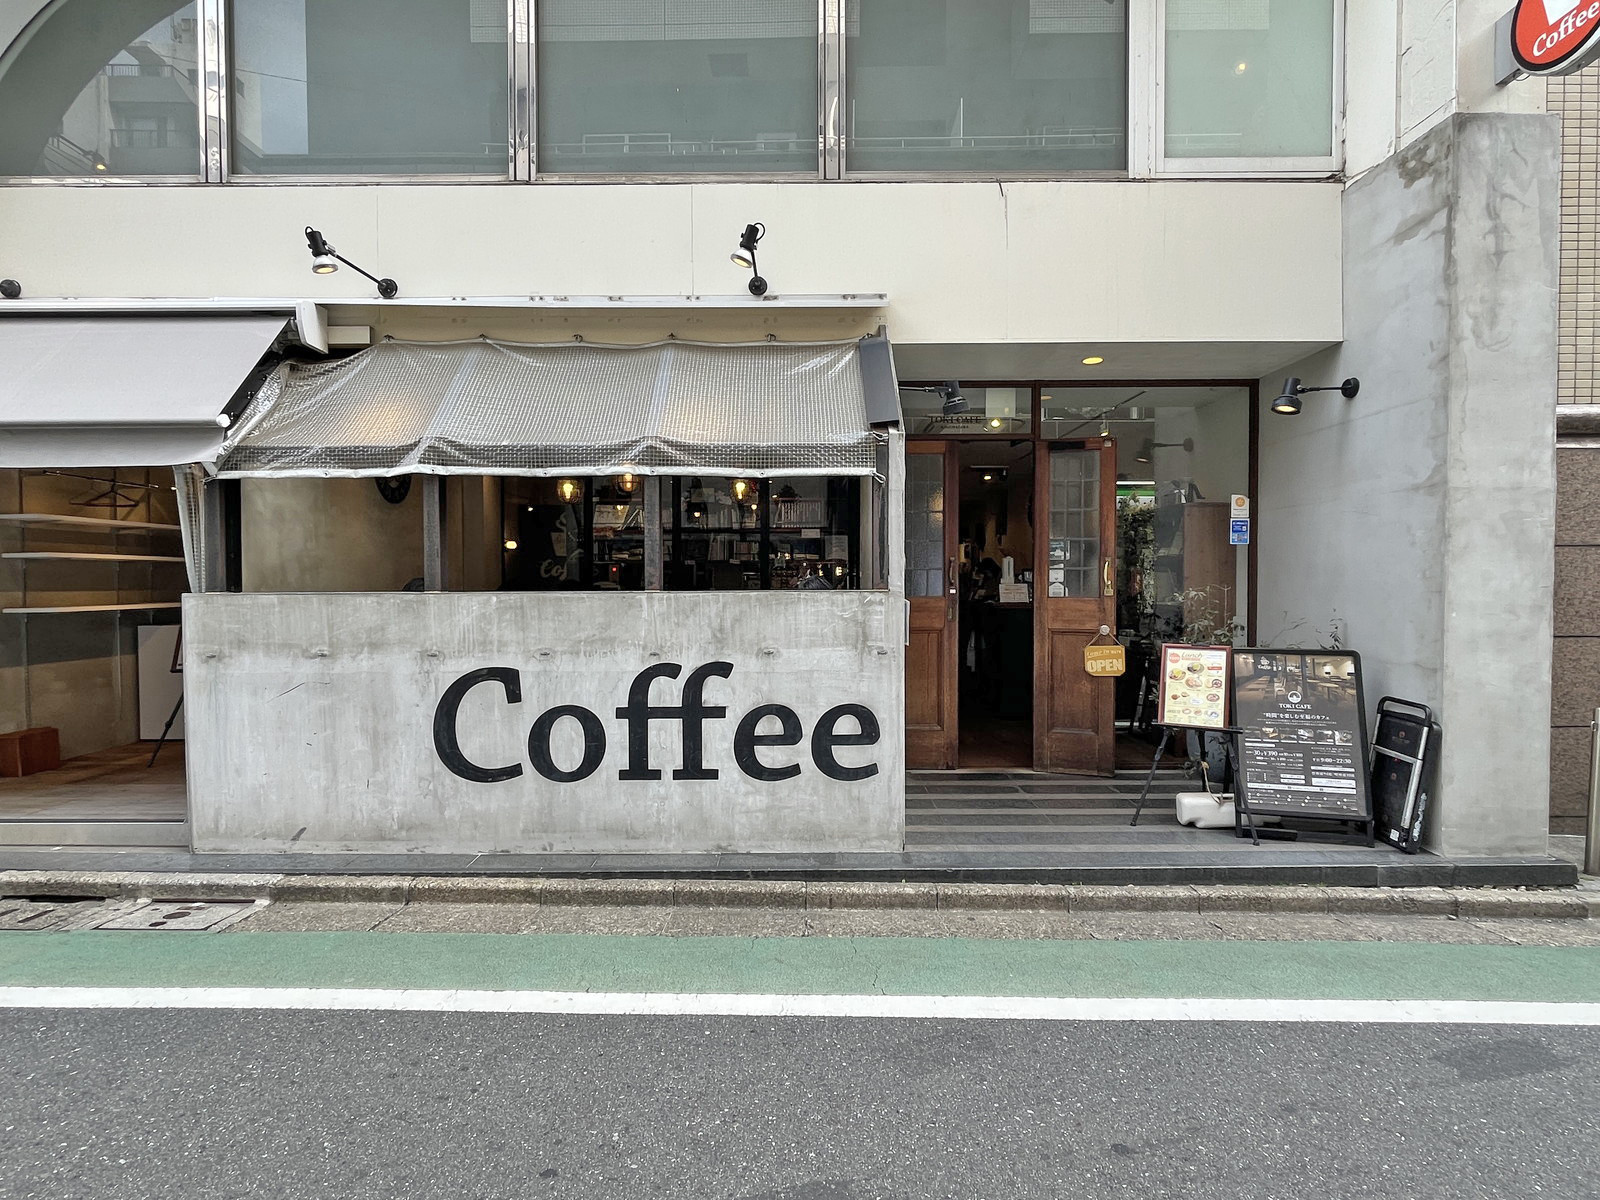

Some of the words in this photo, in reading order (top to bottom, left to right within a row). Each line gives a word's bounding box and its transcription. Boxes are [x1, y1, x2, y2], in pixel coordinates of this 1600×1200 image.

[1532, 1, 1600, 57] Coffee
[1087, 658, 1123, 672] OPEN
[433, 661, 881, 783] Coffee
